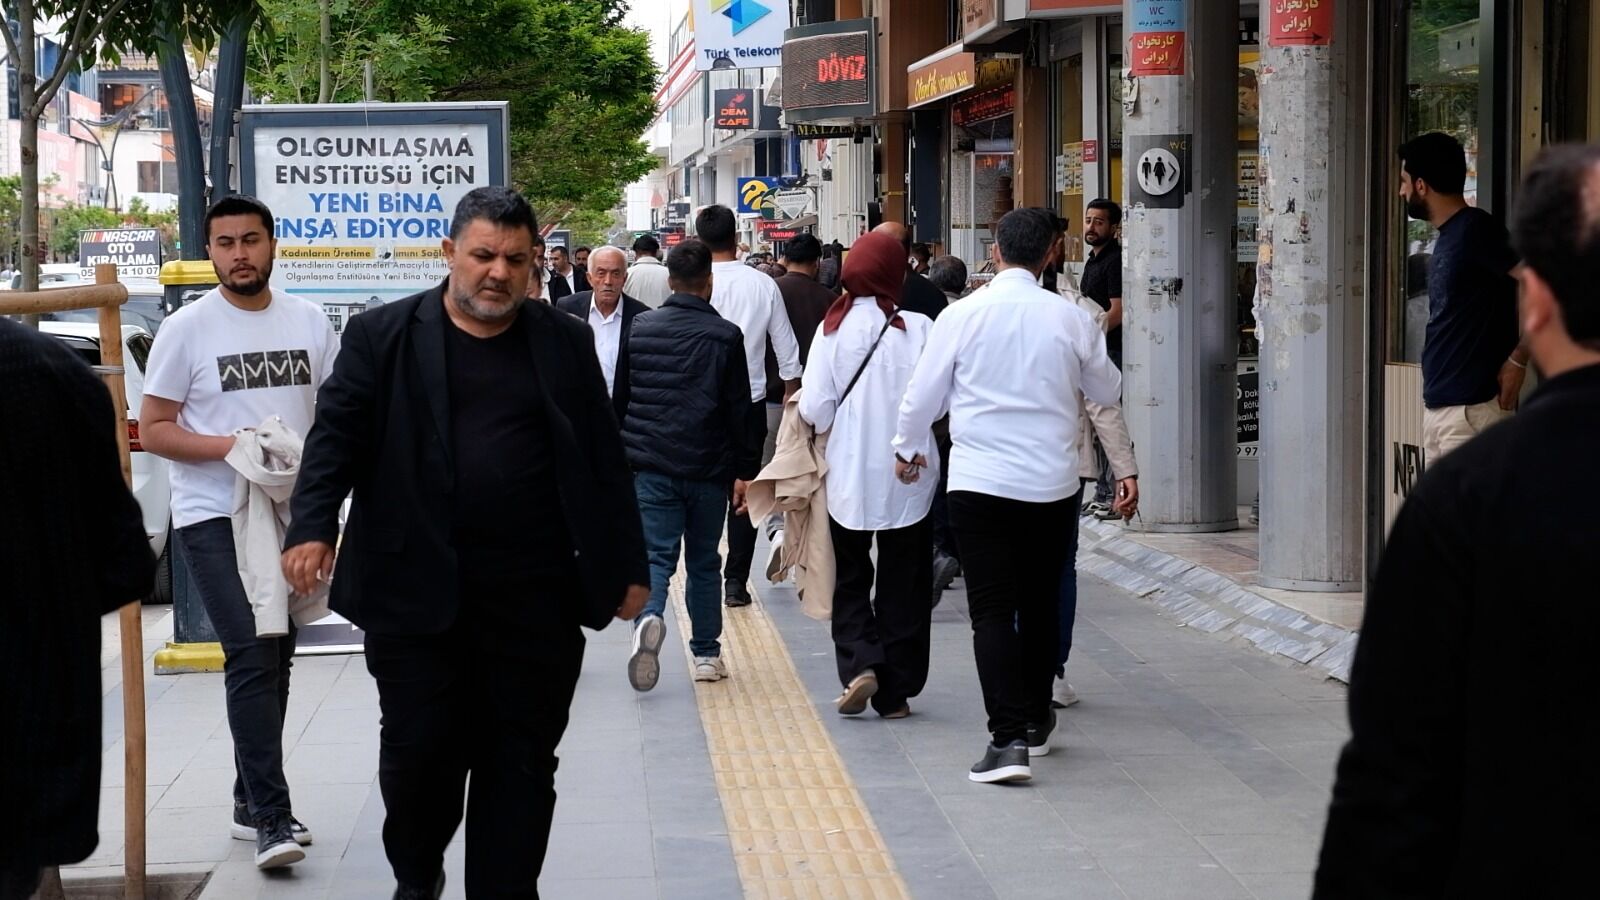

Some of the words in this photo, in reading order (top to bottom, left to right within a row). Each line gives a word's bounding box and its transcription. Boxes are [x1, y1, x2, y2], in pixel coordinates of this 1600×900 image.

[1150, 6, 1165, 15] WC
[1281, 16, 1312, 32] ایرانی
[704, 48, 730, 59] Türk
[1142, 51, 1168, 64] ایرانی
[818, 52, 866, 83] DÖVİZ
[276, 136, 474, 162] OLGUNLAŞMA
[1170, 140, 1187, 150] WC
[101, 230, 156, 242] NASCAR
[108, 243, 135, 254] OTO
[281, 249, 330, 258] Kadınların
[334, 248, 370, 258] Üretime
[337, 261, 390, 270] Geliştirmeleri
[393, 261, 430, 270] Amacıyla
[81, 268, 96, 277] 05
[286, 272, 334, 282] Olgunlaşma
[1244, 447, 1258, 456] 97
